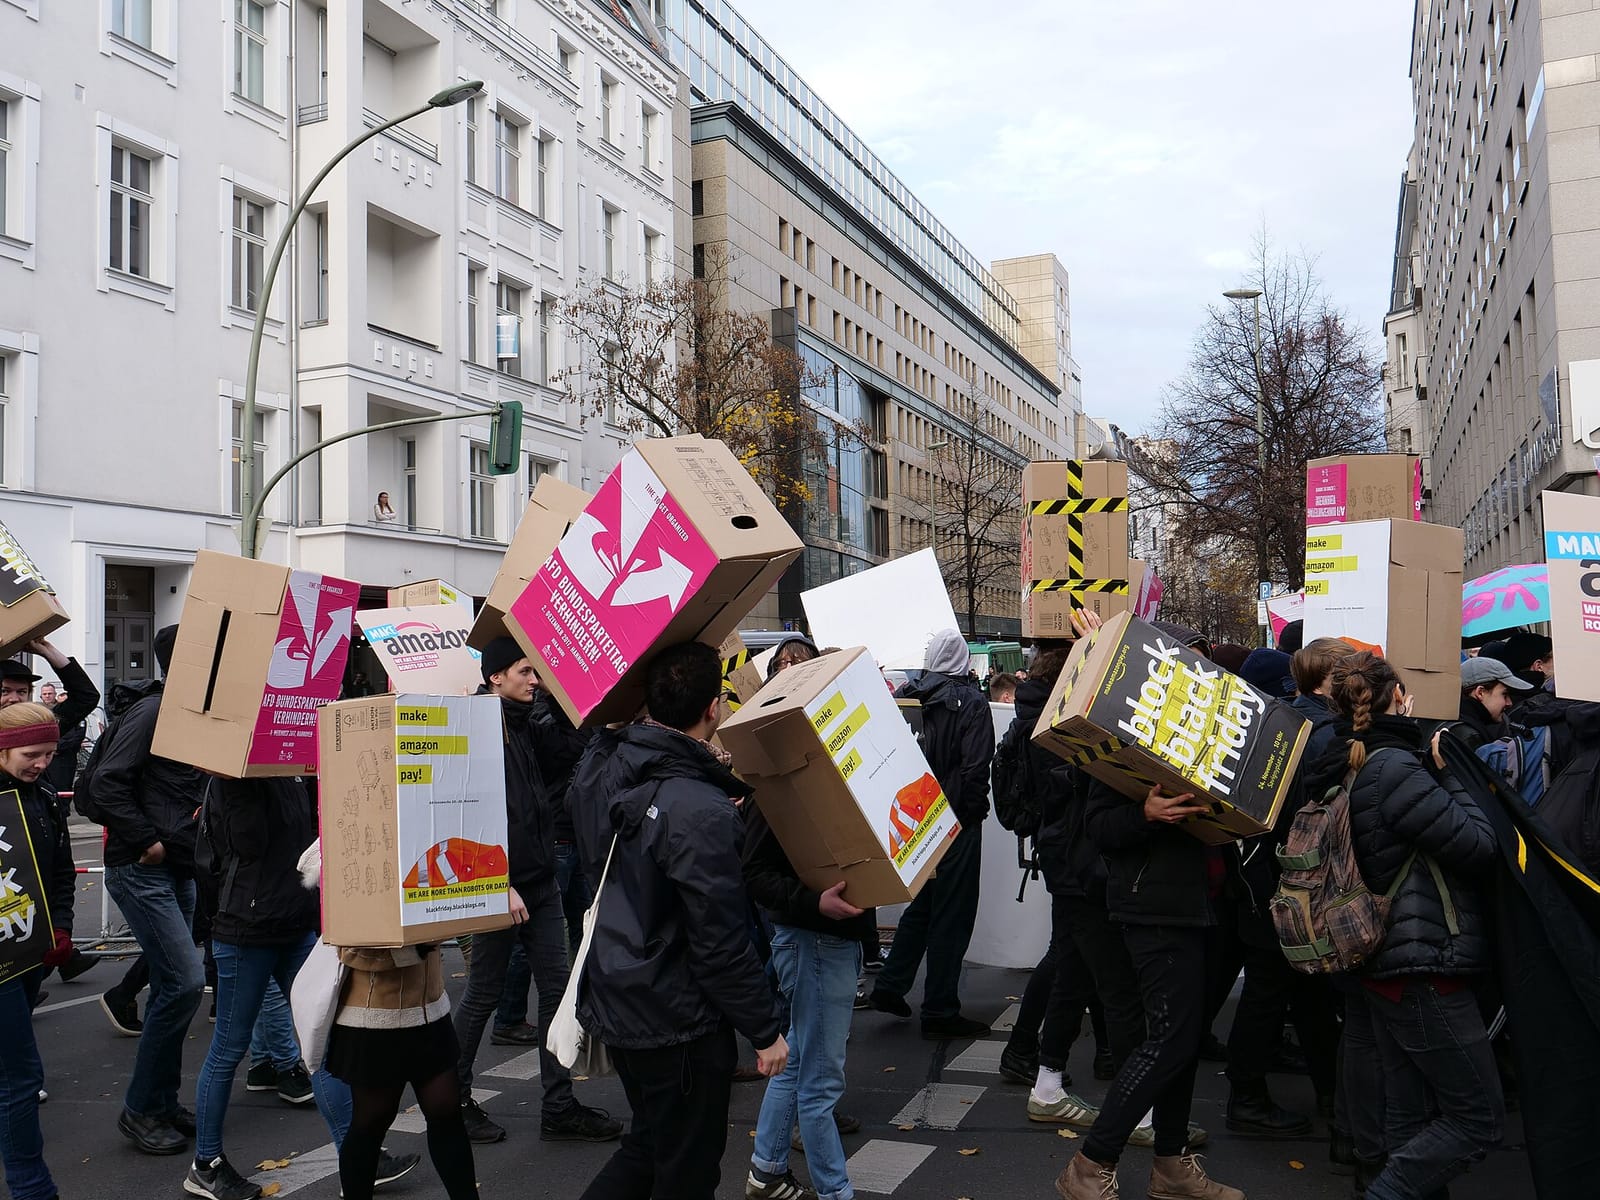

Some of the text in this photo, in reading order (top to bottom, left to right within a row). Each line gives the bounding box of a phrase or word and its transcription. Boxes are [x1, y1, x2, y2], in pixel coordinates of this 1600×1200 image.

[644, 483, 655, 498] TIME
[1307, 539, 1327, 549] make
[1306, 561, 1335, 570] amazon
[1262, 584, 1269, 598] P
[1305, 583, 1322, 594] pay!
[543, 554, 628, 675] AFD BUNDESPARTEITAG
[550, 589, 602, 665] VERHINDERN!
[1118, 638, 1181, 749] block
[400, 710, 428, 721] make
[815, 708, 833, 729] make
[1158, 661, 1219, 768] black
[828, 725, 852, 752] amazon
[1198, 675, 1266, 795] friday
[400, 740, 439, 750] amazon
[842, 755, 856, 778] pay!
[400, 768, 422, 783] pay!
[408, 891, 417, 899] WE
[431, 888, 446, 896] MORE
